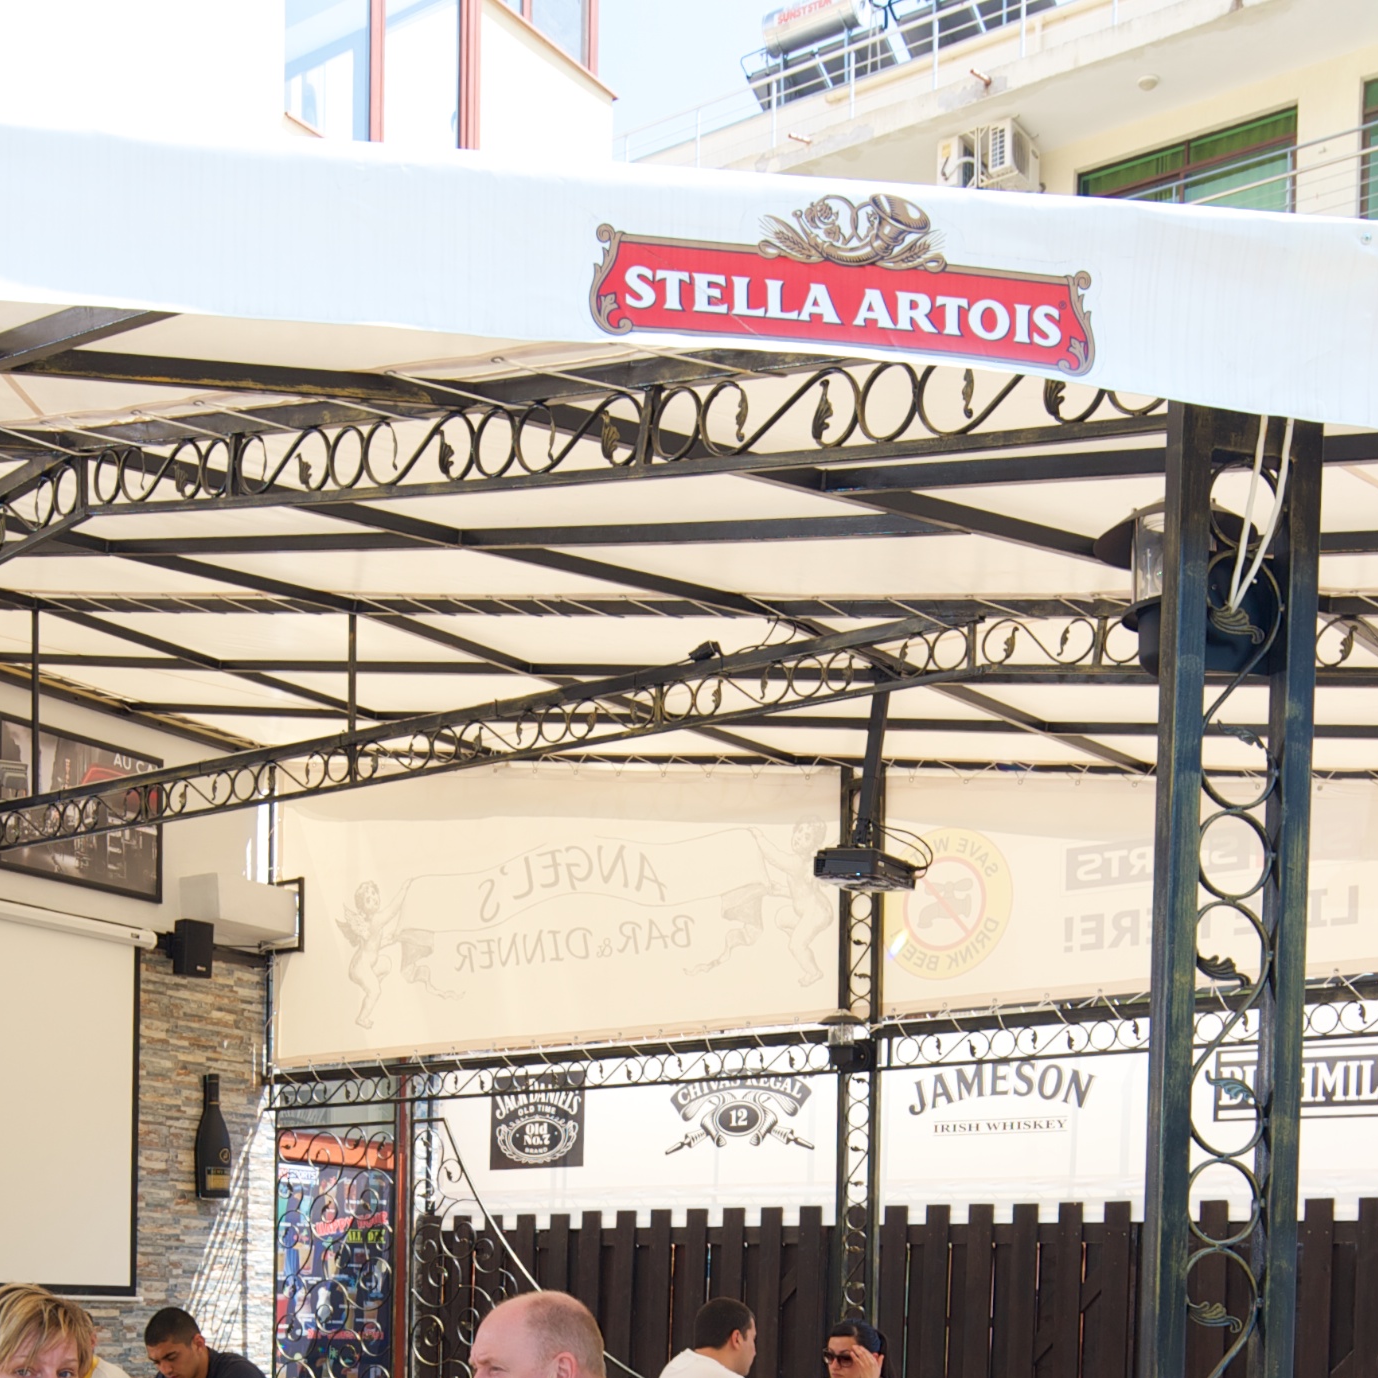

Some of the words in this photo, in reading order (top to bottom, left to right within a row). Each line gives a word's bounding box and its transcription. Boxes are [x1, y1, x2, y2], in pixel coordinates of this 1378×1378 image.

[624, 264, 843, 326] STELLA
[853, 286, 1063, 348] ARTOIS
[113, 753, 132, 771] AU
[908, 1060, 1098, 1117] JAMESON
[517, 1105, 535, 1117] OLD
[537, 1104, 557, 1115] TIME
[729, 1108, 748, 1127] 12
[525, 1122, 549, 1135] Old
[933, 1121, 981, 1135] IRISH
[986, 1118, 1069, 1133] WHISKEY
[523, 1133, 551, 1146] No.7
[315, 1216, 354, 1237] HAPPY
